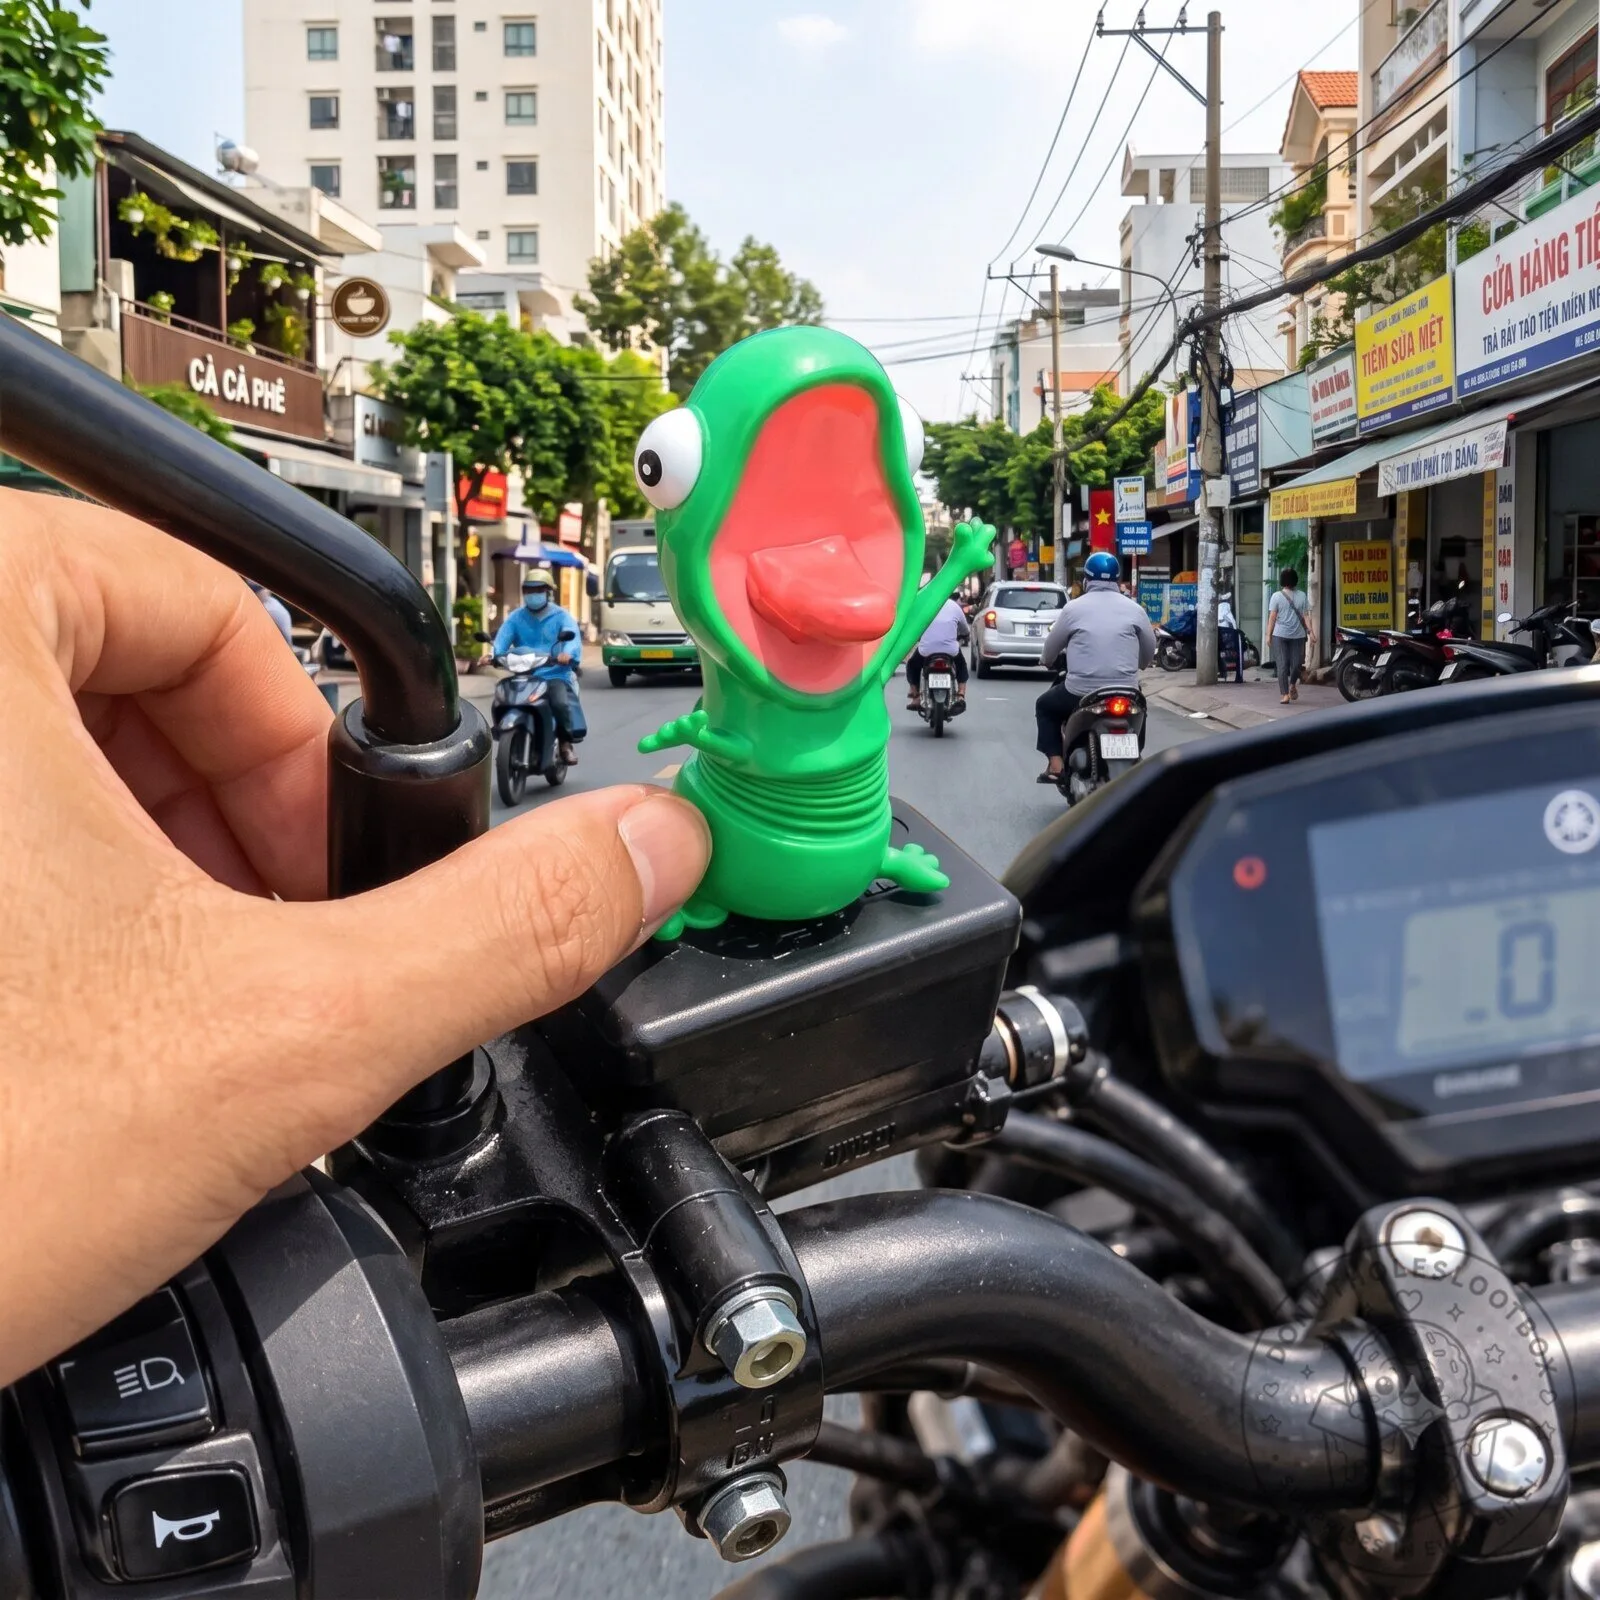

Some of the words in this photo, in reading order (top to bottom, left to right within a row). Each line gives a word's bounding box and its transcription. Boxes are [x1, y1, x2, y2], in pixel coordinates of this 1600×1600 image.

[1520, 238, 1569, 298] HÀNG
[189, 353, 219, 397] CÀ
[222, 364, 250, 405] CÀ
[252, 377, 286, 414] PHÊ
[1498, 918, 1558, 1022] 0
